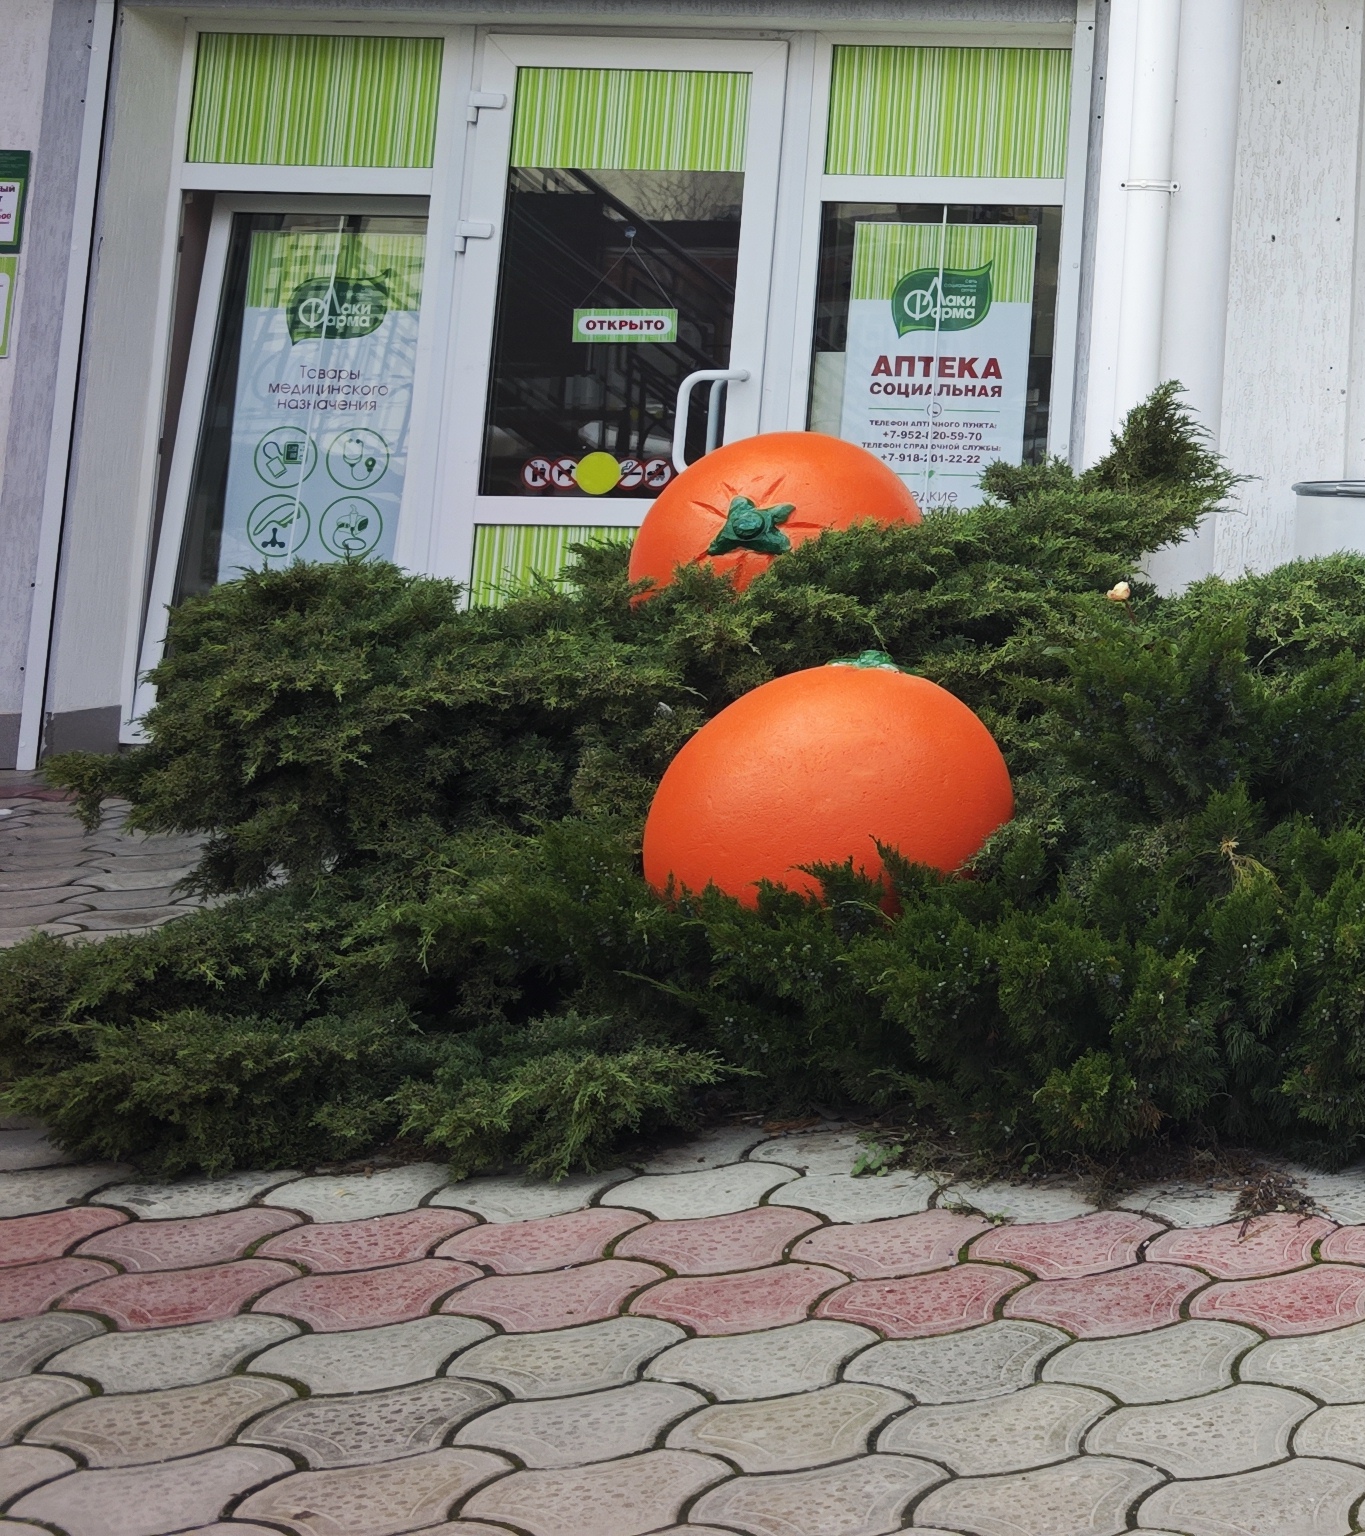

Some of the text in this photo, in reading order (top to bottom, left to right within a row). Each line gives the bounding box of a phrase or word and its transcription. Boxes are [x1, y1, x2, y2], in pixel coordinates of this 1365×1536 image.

[585, 319, 665, 332] ОТКРЫТО
[871, 355, 1003, 379] АПТЕКА
[268, 383, 389, 396] медицинского
[869, 383, 1003, 398] СОЦИАЛЬНАЯ
[277, 399, 377, 411] назначения
[869, 419, 909, 427] ТЕЛЕФОН
